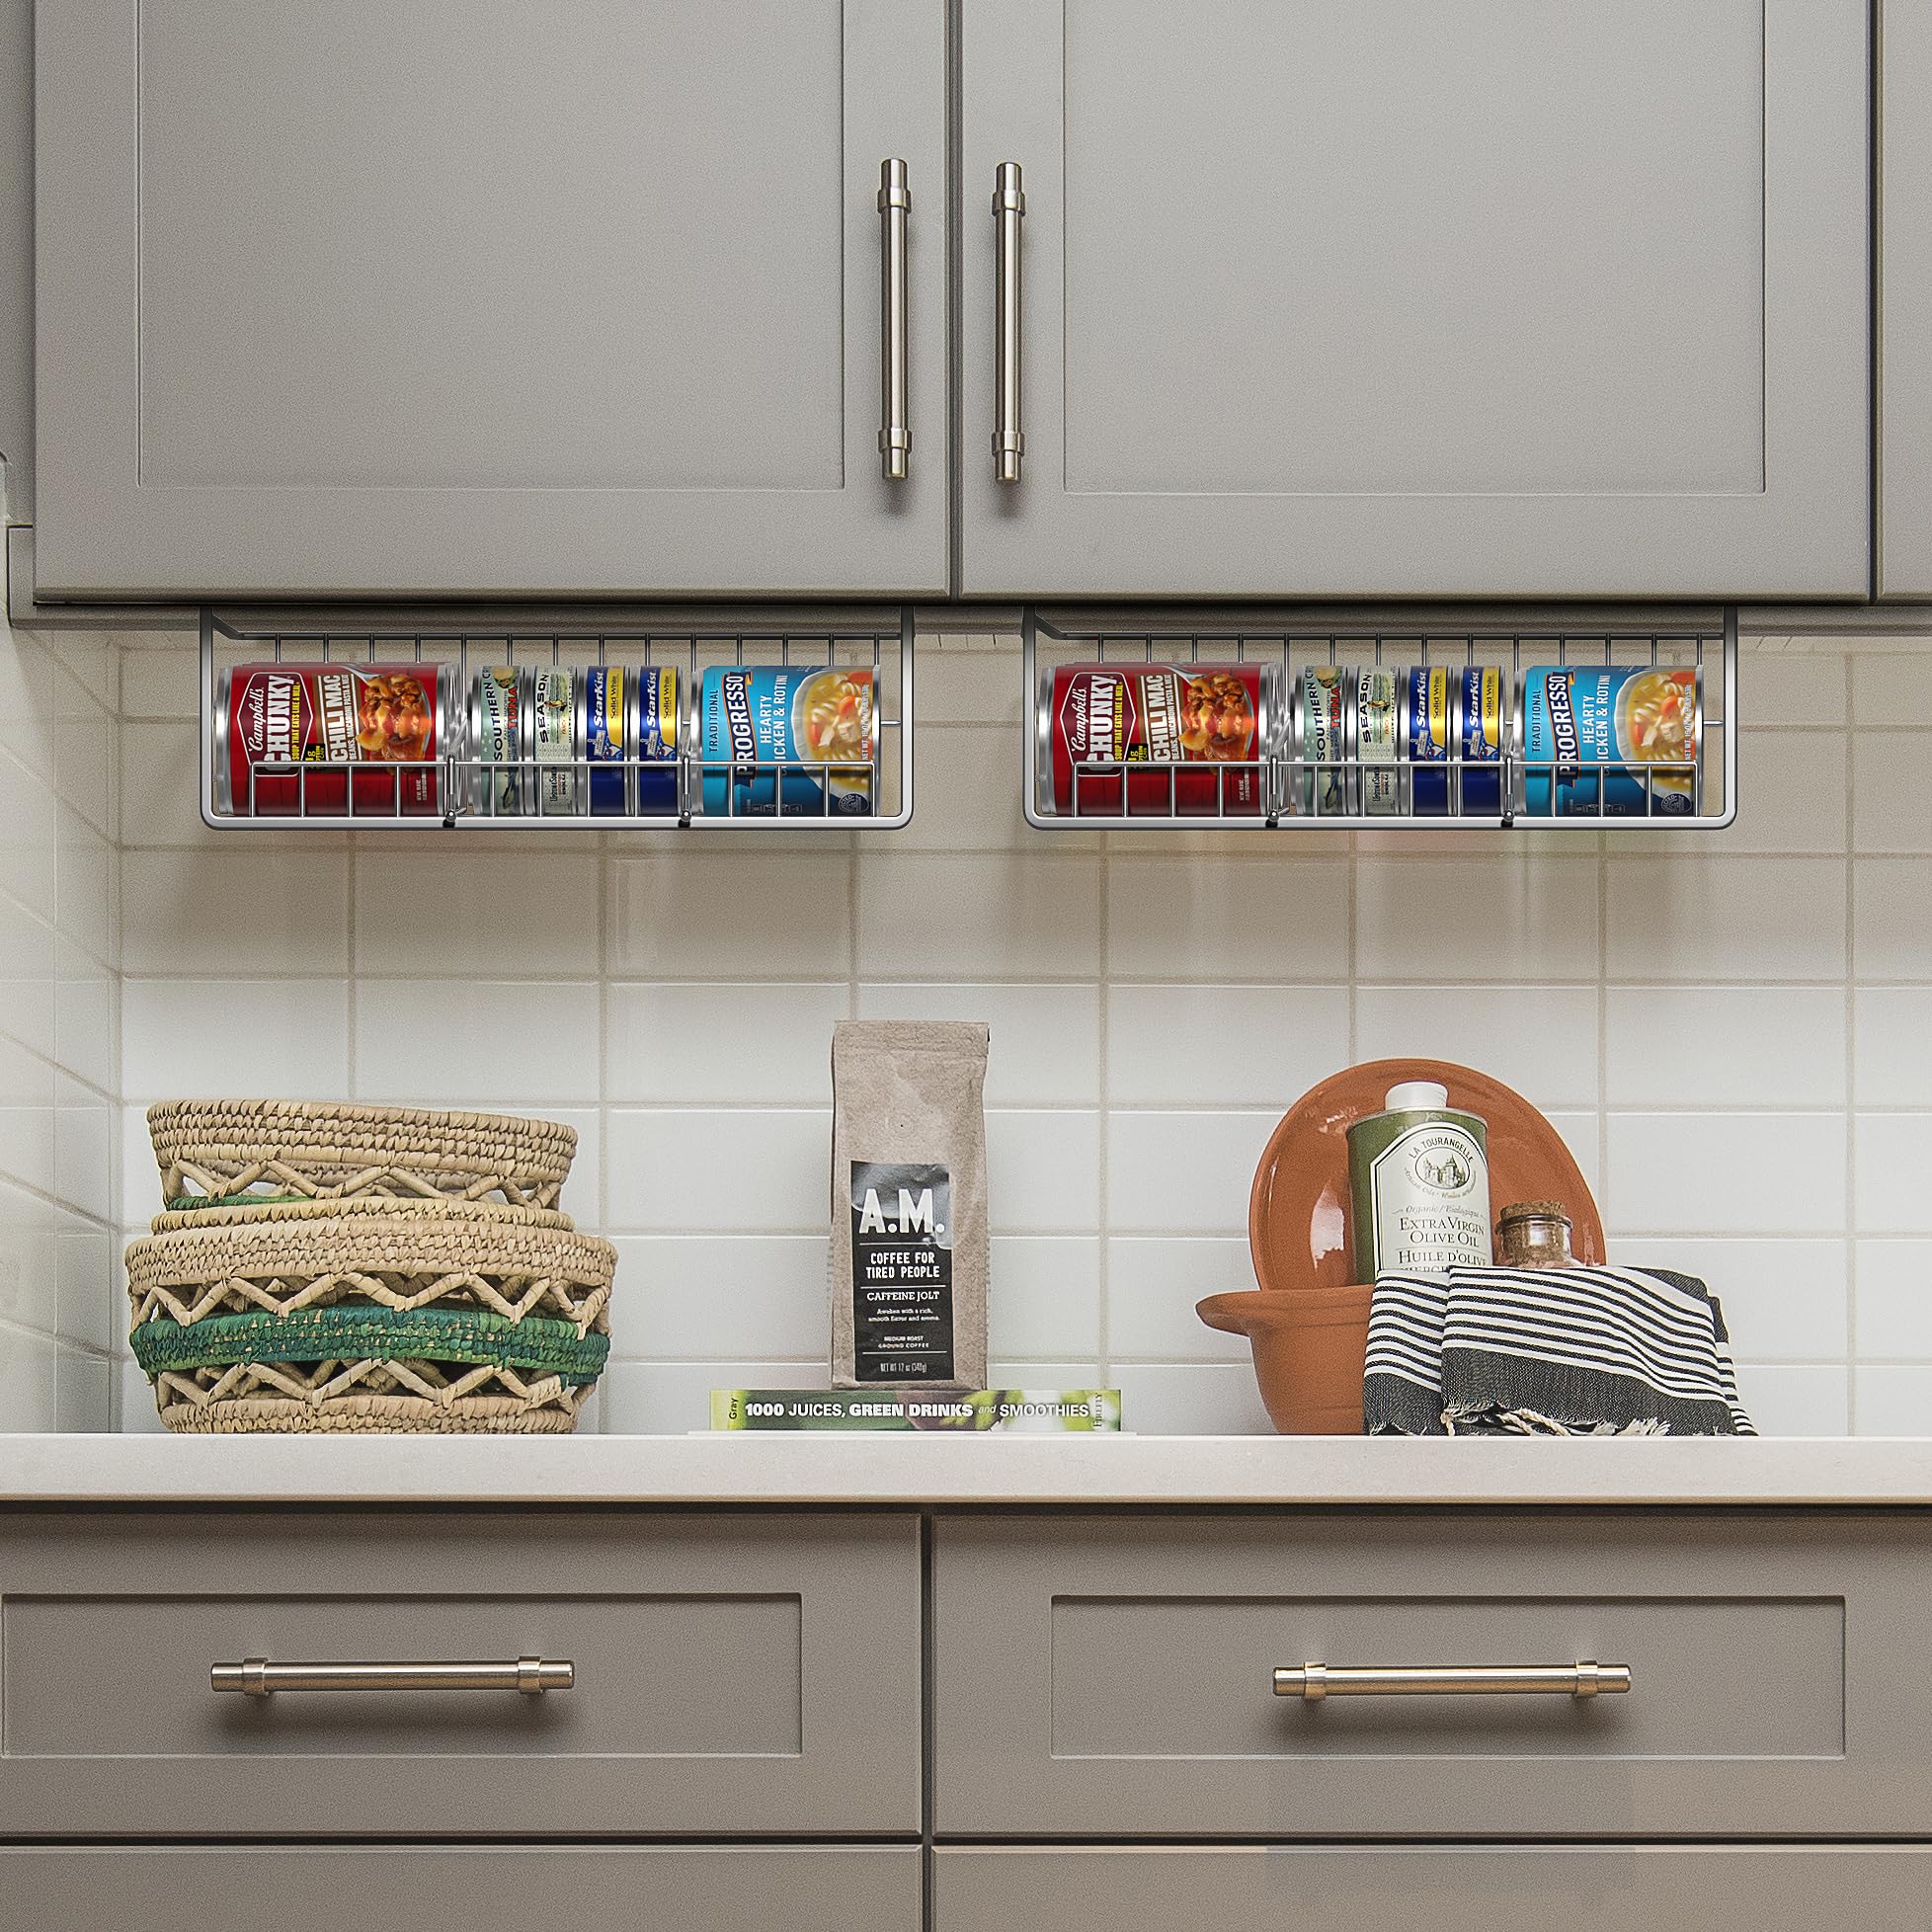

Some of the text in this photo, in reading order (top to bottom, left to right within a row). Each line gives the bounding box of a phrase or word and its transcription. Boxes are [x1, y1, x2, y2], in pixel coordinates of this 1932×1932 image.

[508, 685, 518, 728] TUNA
[536, 674, 549, 743] SEASON
[594, 672, 604, 728] StarKist
[646, 672, 656, 728] StarKist
[774, 675, 788, 703] ROTINI
[774, 707, 785, 716] &
[1330, 685, 1340, 728] TUNA
[1359, 674, 1372, 743] SEASON
[1416, 672, 1426, 728] StarKist
[1469, 672, 1479, 728] StarKist
[1597, 675, 1611, 703] ROTINI
[1597, 707, 1608, 716] &
[248, 687, 266, 752] Campbell's
[265, 675, 294, 770] CHUNKY
[323, 675, 348, 761] CHILI MAC
[486, 682, 503, 761] SOUTHERN
[709, 689, 718, 753] TRADITIONAL
[725, 676, 754, 775] PROGRESSO
[761, 694, 772, 743] HEARTY
[1071, 687, 1088, 752] Campbell's
[1087, 675, 1117, 770] CHUNKY
[1146, 675, 1170, 761] CHILI MAC
[1309, 682, 1326, 761] SOUTHERN
[1532, 689, 1541, 753] TRADITIONAL
[1548, 676, 1576, 775] PROGRESSO
[1583, 694, 1595, 743] HEARTY
[1409, 1137, 1474, 1163] LA TOURANGELLE
[859, 1188, 945, 1234] A.M.
[1401, 1216, 1485, 1236] EXTRA VIRGIN
[871, 1252, 935, 1264] COFFEE FOR
[1399, 1250, 1444, 1264] HUILE
[1410, 1230, 1479, 1248] OLIVE OIL
[866, 1266, 940, 1279] TIRED PEOPLE
[867, 1291, 940, 1302] CAFFEINE JOLT
[729, 1398, 739, 1419] Gray
[745, 1403, 1088, 1418] 1000 JUICES, GREEN DRINKS and SMOOTHIES
